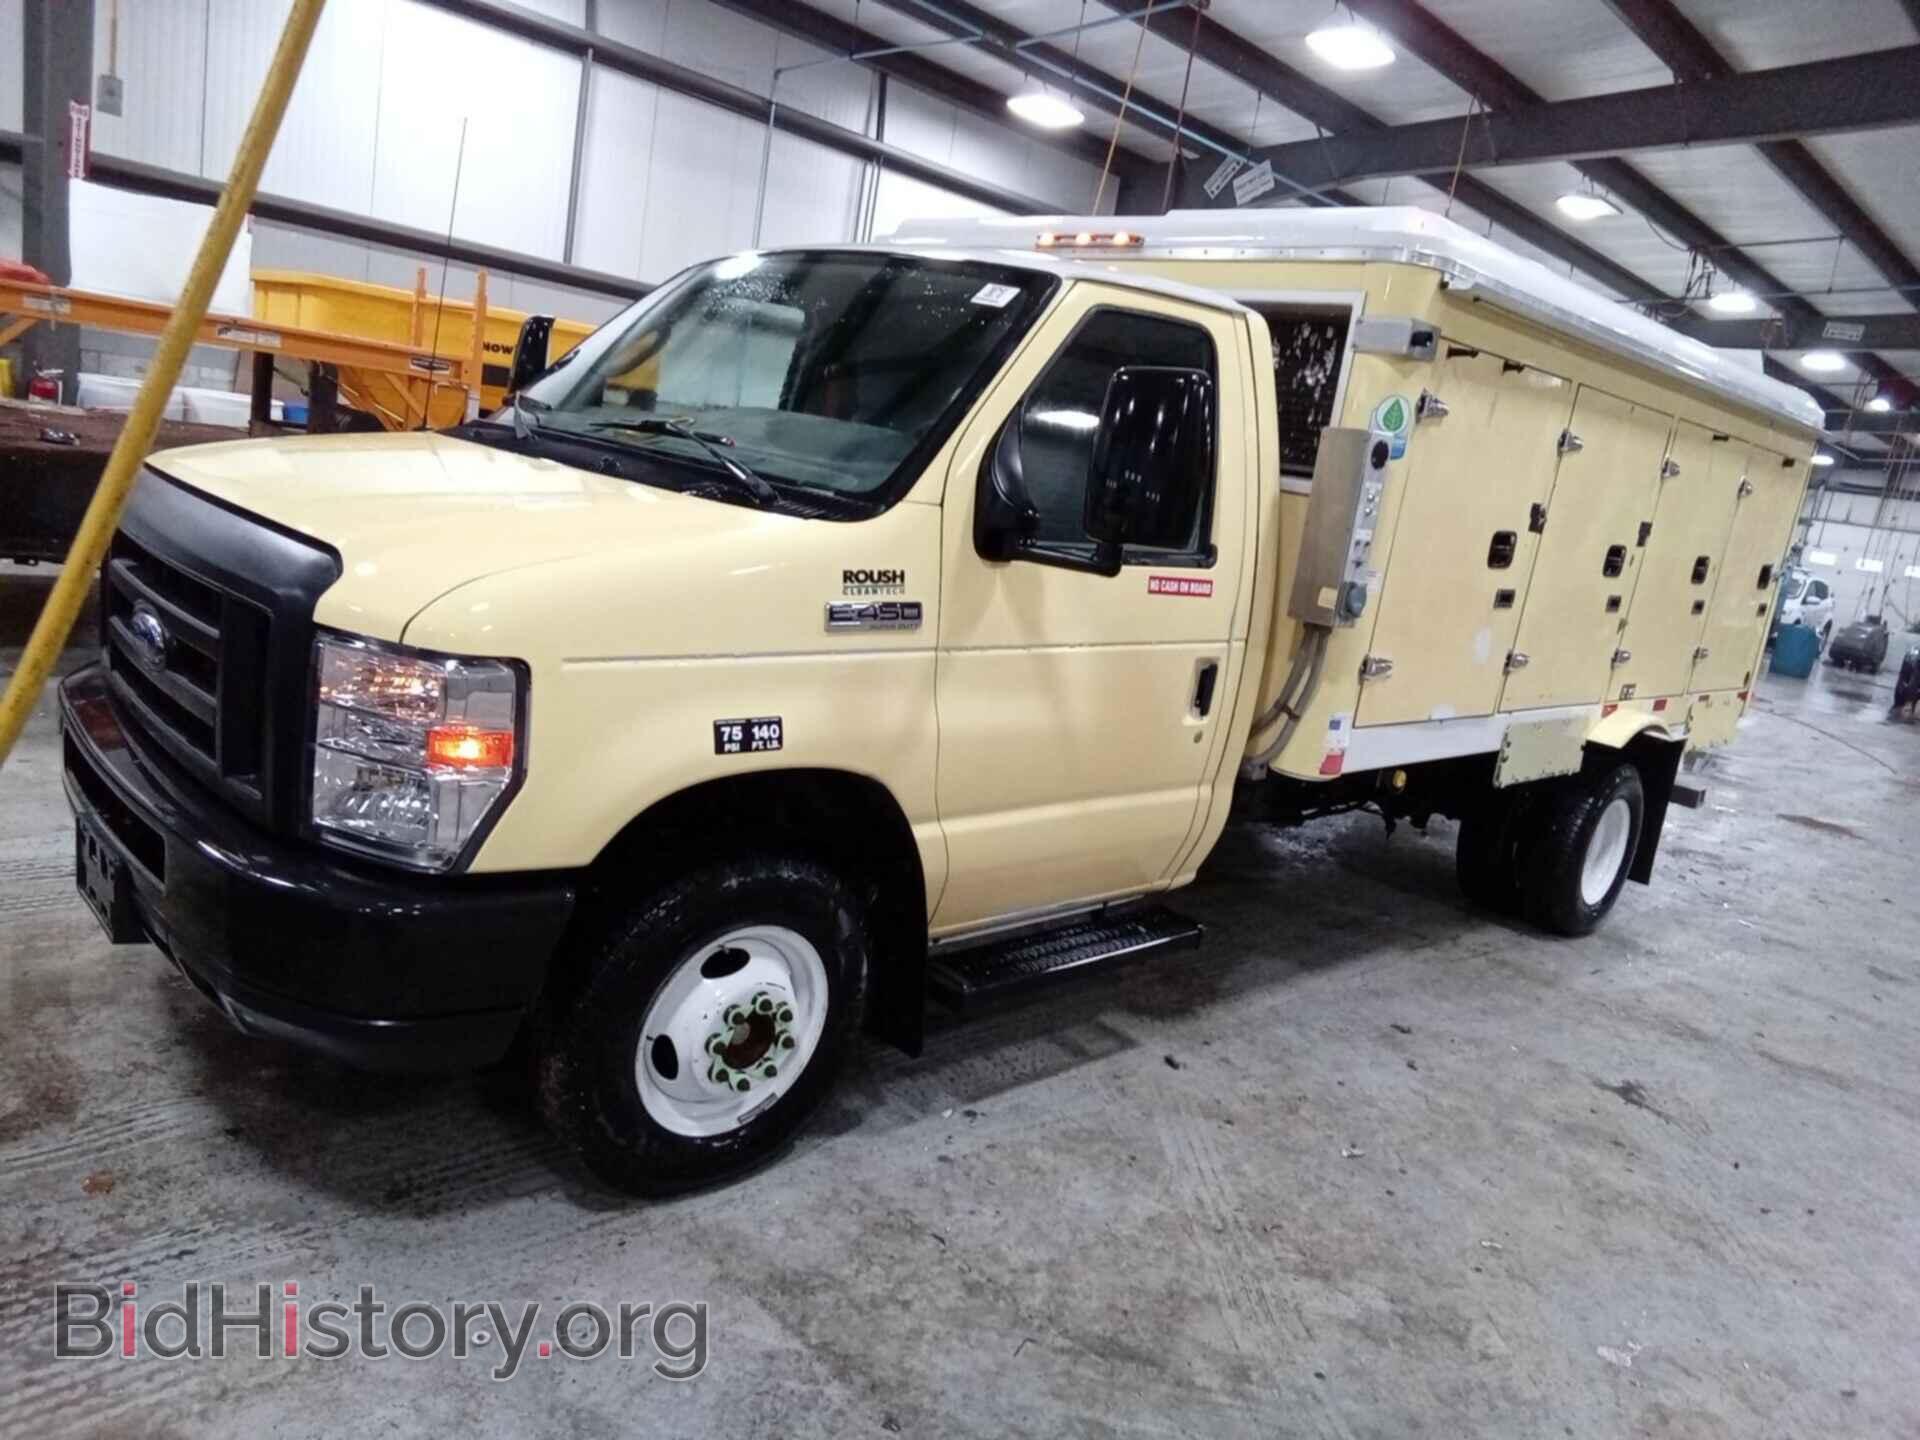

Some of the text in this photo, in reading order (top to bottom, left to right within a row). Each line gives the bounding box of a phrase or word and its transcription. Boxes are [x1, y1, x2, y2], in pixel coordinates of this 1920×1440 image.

[483, 341, 514, 355] NOW
[842, 569, 905, 584] ROUSH
[1161, 579, 1179, 593] CASH
[1190, 580, 1211, 595] BOARD
[720, 725, 743, 742] 75
[751, 723, 780, 740] 140
[723, 742, 740, 752] PSI
